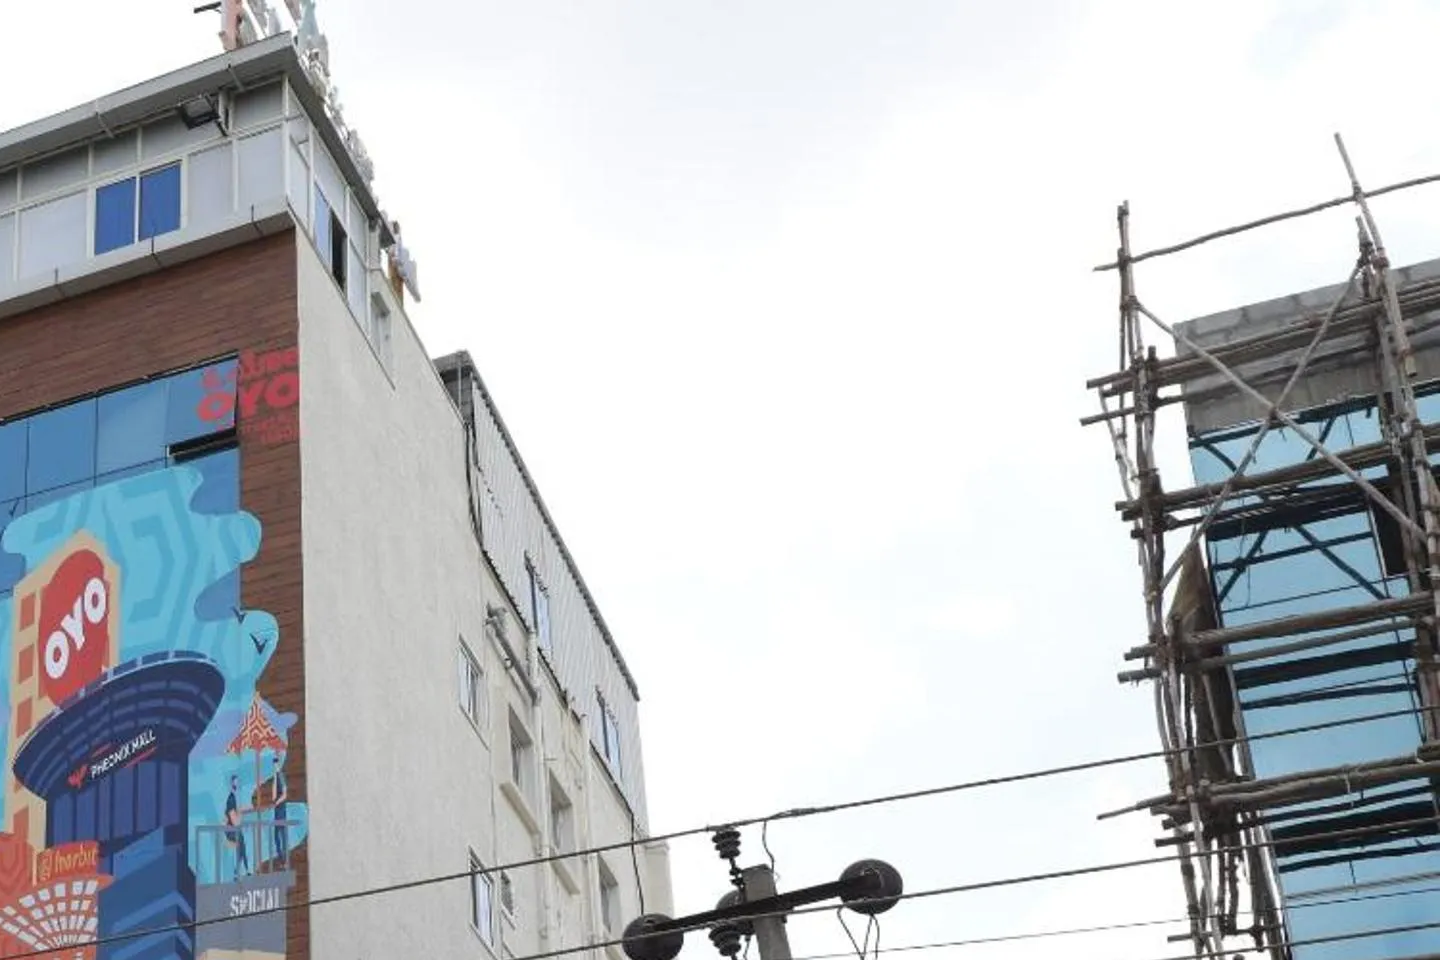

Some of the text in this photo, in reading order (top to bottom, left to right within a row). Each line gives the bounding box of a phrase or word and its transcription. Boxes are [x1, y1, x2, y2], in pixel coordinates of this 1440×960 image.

[197, 372, 299, 422] OYO
[45, 577, 107, 680] OYO
[131, 729, 157, 755] MALL
